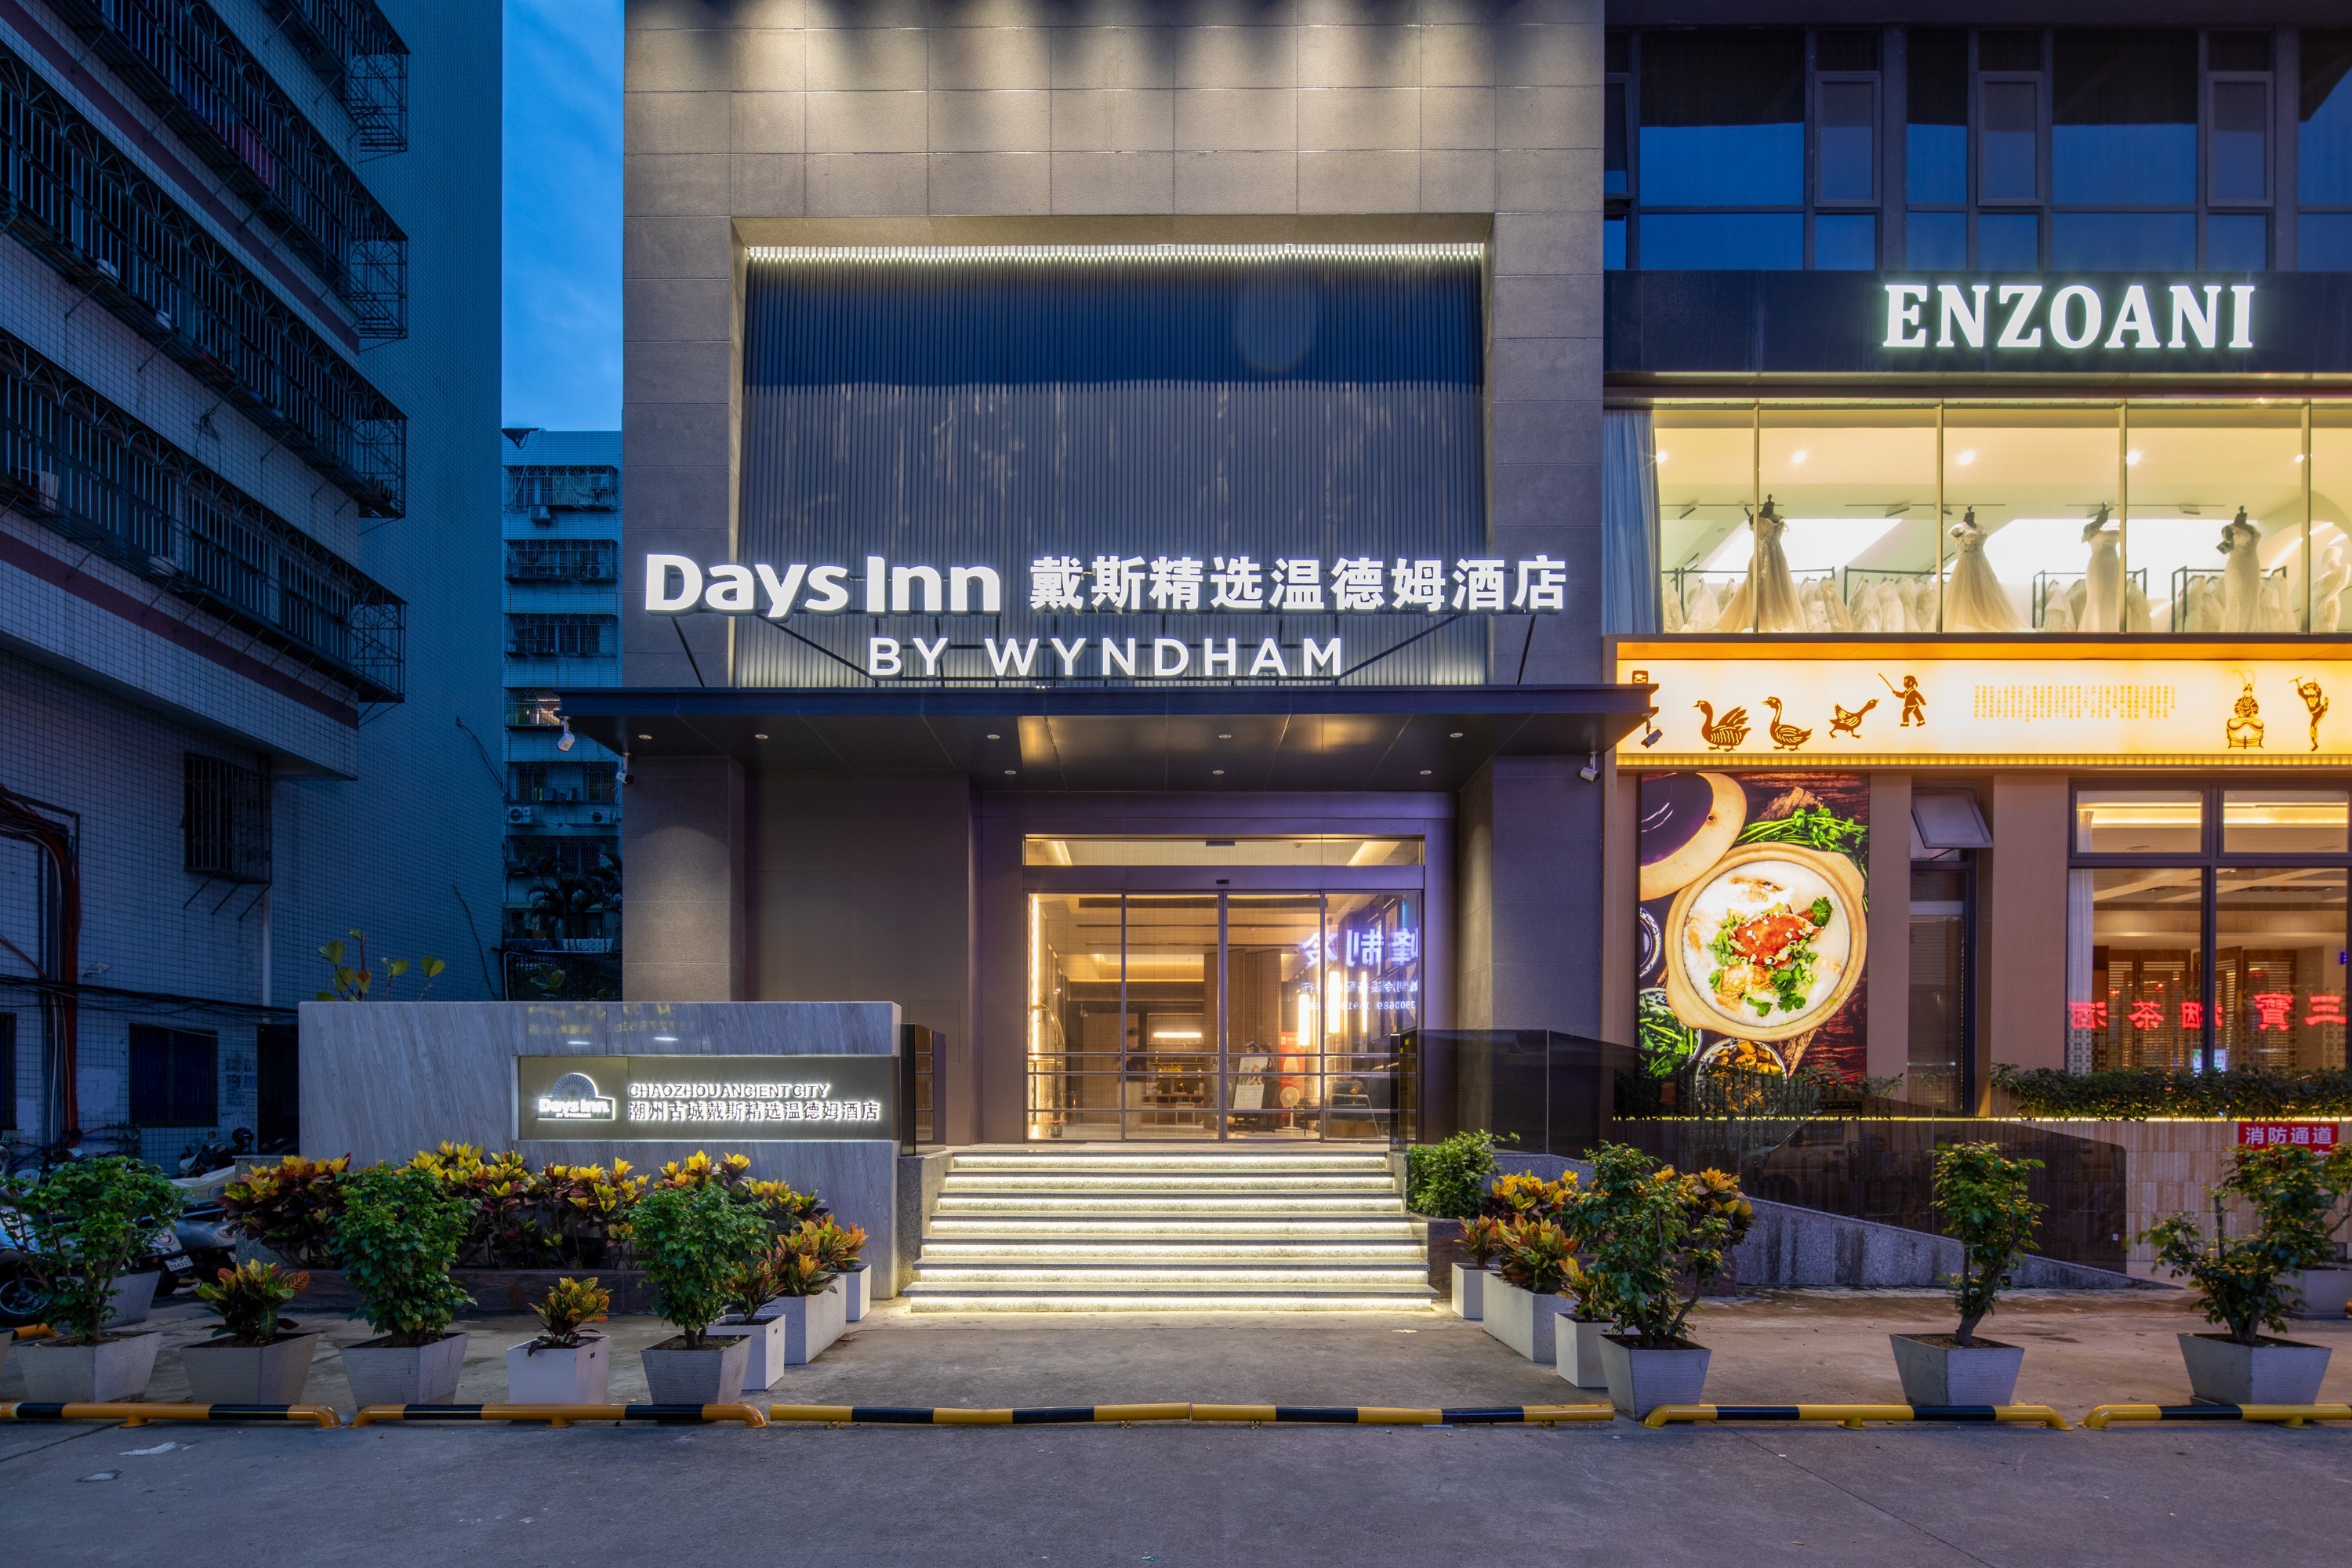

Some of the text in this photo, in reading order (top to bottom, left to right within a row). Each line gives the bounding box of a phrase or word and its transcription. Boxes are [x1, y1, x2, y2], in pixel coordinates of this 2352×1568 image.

[1883, 285, 2255, 348] ENZOANI
[644, 554, 1001, 618] Days Inn
[1029, 556, 1567, 612] 戴斯精选温德姆酒店
[869, 637, 1343, 677] BY WYNDHAM
[629, 1084, 829, 1098] CHAOZHOU ANCIENT CITY
[539, 1099, 579, 1113] Days
[629, 1102, 880, 1120] 潮州古城戴斯精选温德姆酒店
[2245, 1127, 2332, 1144] 消防通道
[169, 1260, 191, 1270] 264327
